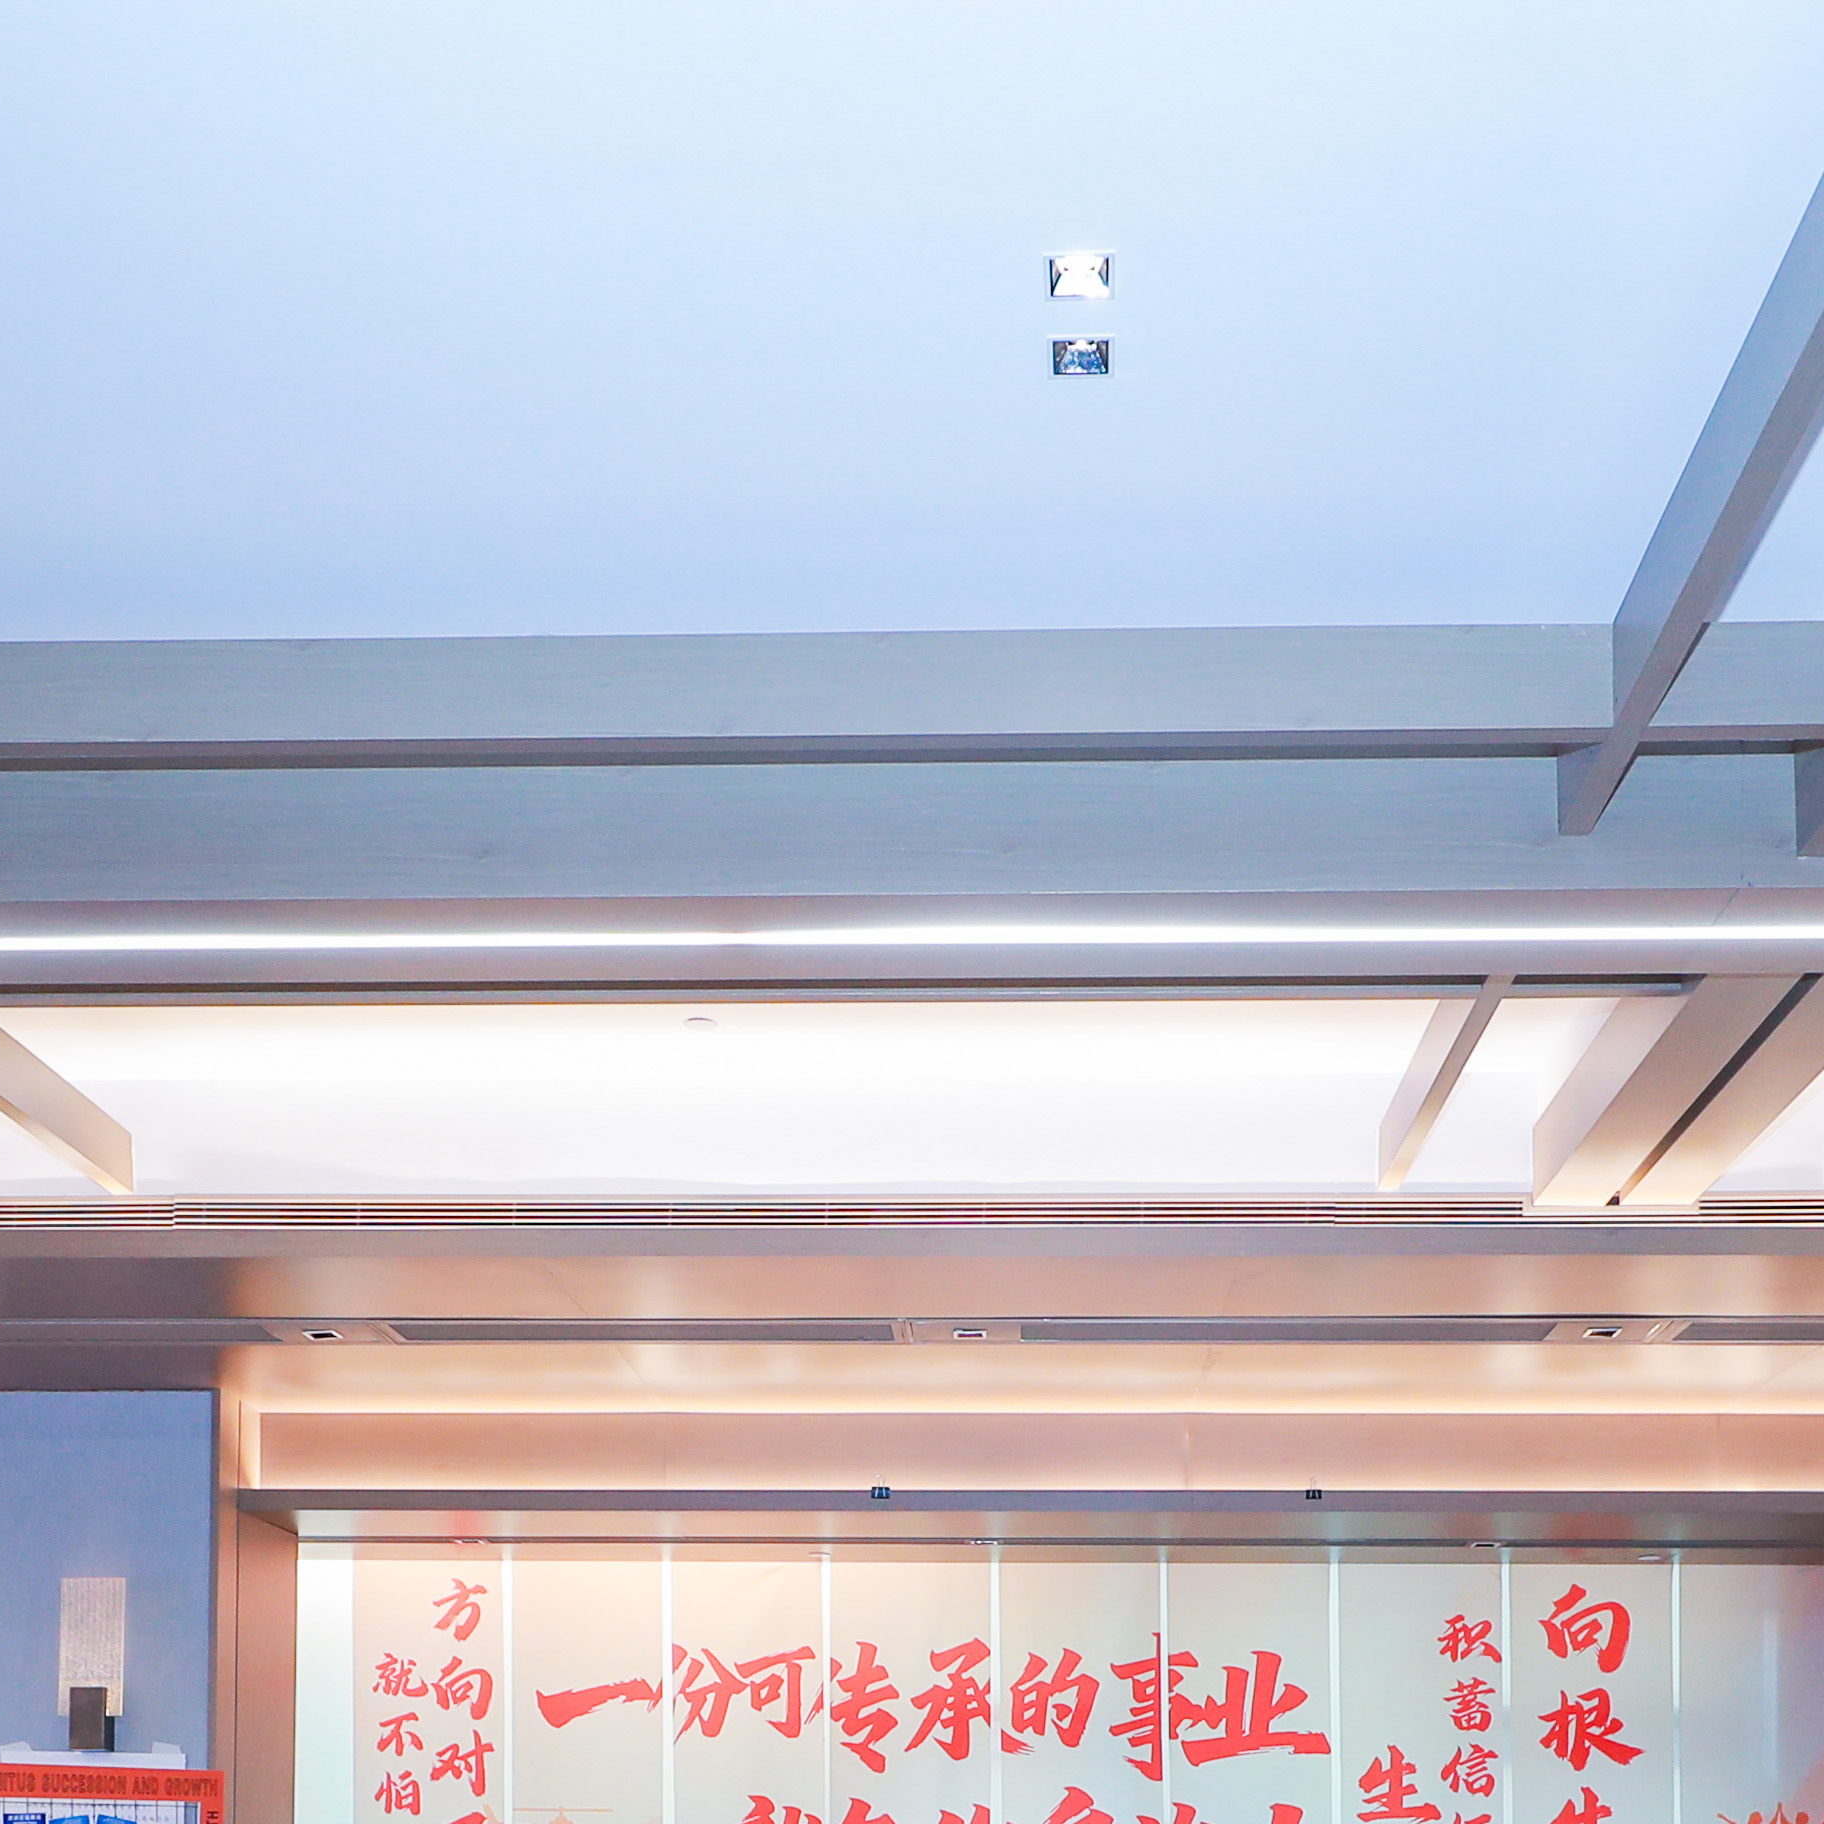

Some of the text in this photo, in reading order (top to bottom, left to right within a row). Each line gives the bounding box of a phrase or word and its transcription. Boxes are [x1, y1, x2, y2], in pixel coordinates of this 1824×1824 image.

[536, 1632, 1331, 1782] 一份可传承的事业
[41, 1772, 127, 1795] SUCCESSION
[132, 1776, 159, 1795] AND
[164, 1778, 218, 1797] GROWTH
